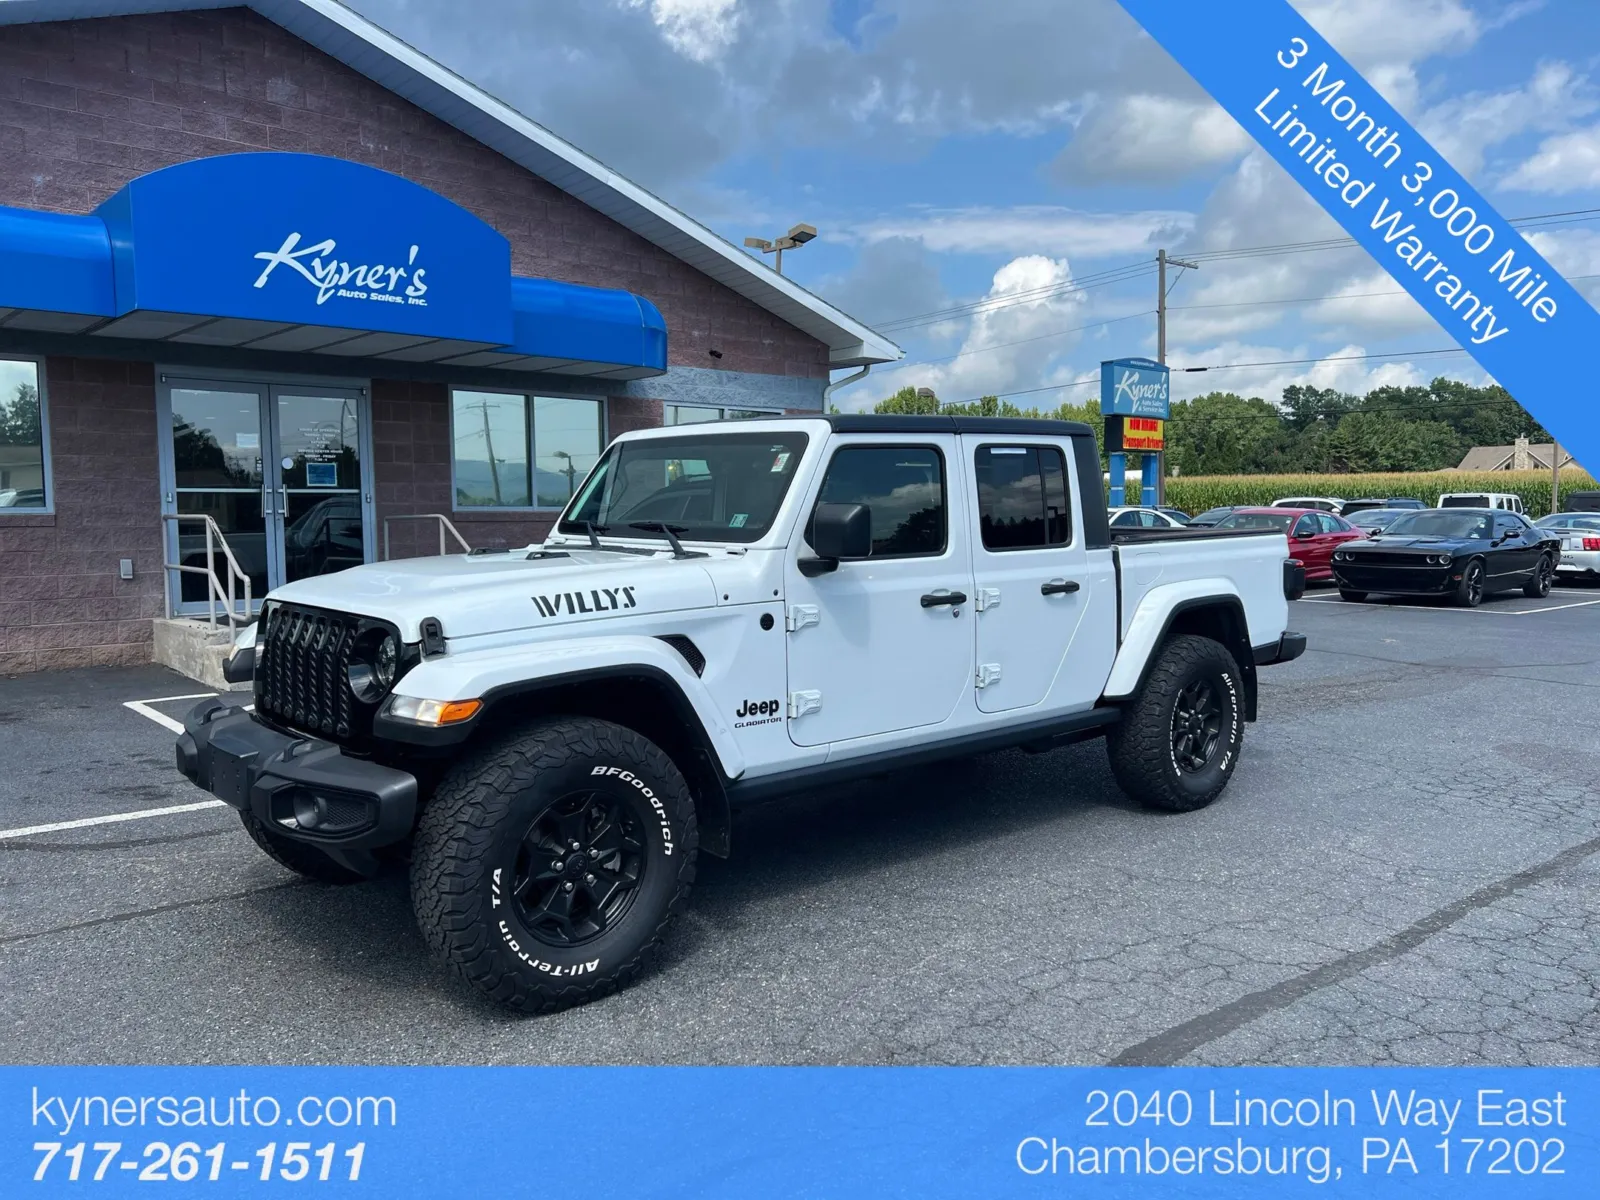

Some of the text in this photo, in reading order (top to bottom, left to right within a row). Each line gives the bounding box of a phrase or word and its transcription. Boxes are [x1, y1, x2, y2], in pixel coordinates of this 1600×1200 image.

[253, 231, 428, 306] Kyner's
[337, 288, 428, 306] Auto Sales, Inc.
[1114, 370, 1167, 414] Kyner's
[531, 586, 637, 618] WILLYS
[734, 716, 782, 728] GLADIATOR
[736, 699, 780, 718] Jeep
[1221, 672, 1237, 744] All-Terrain
[1220, 751, 1232, 770] T/A
[591, 766, 674, 856] BFGoodrich
[492, 868, 502, 909] T/A
[498, 920, 600, 976] All-Terrain
